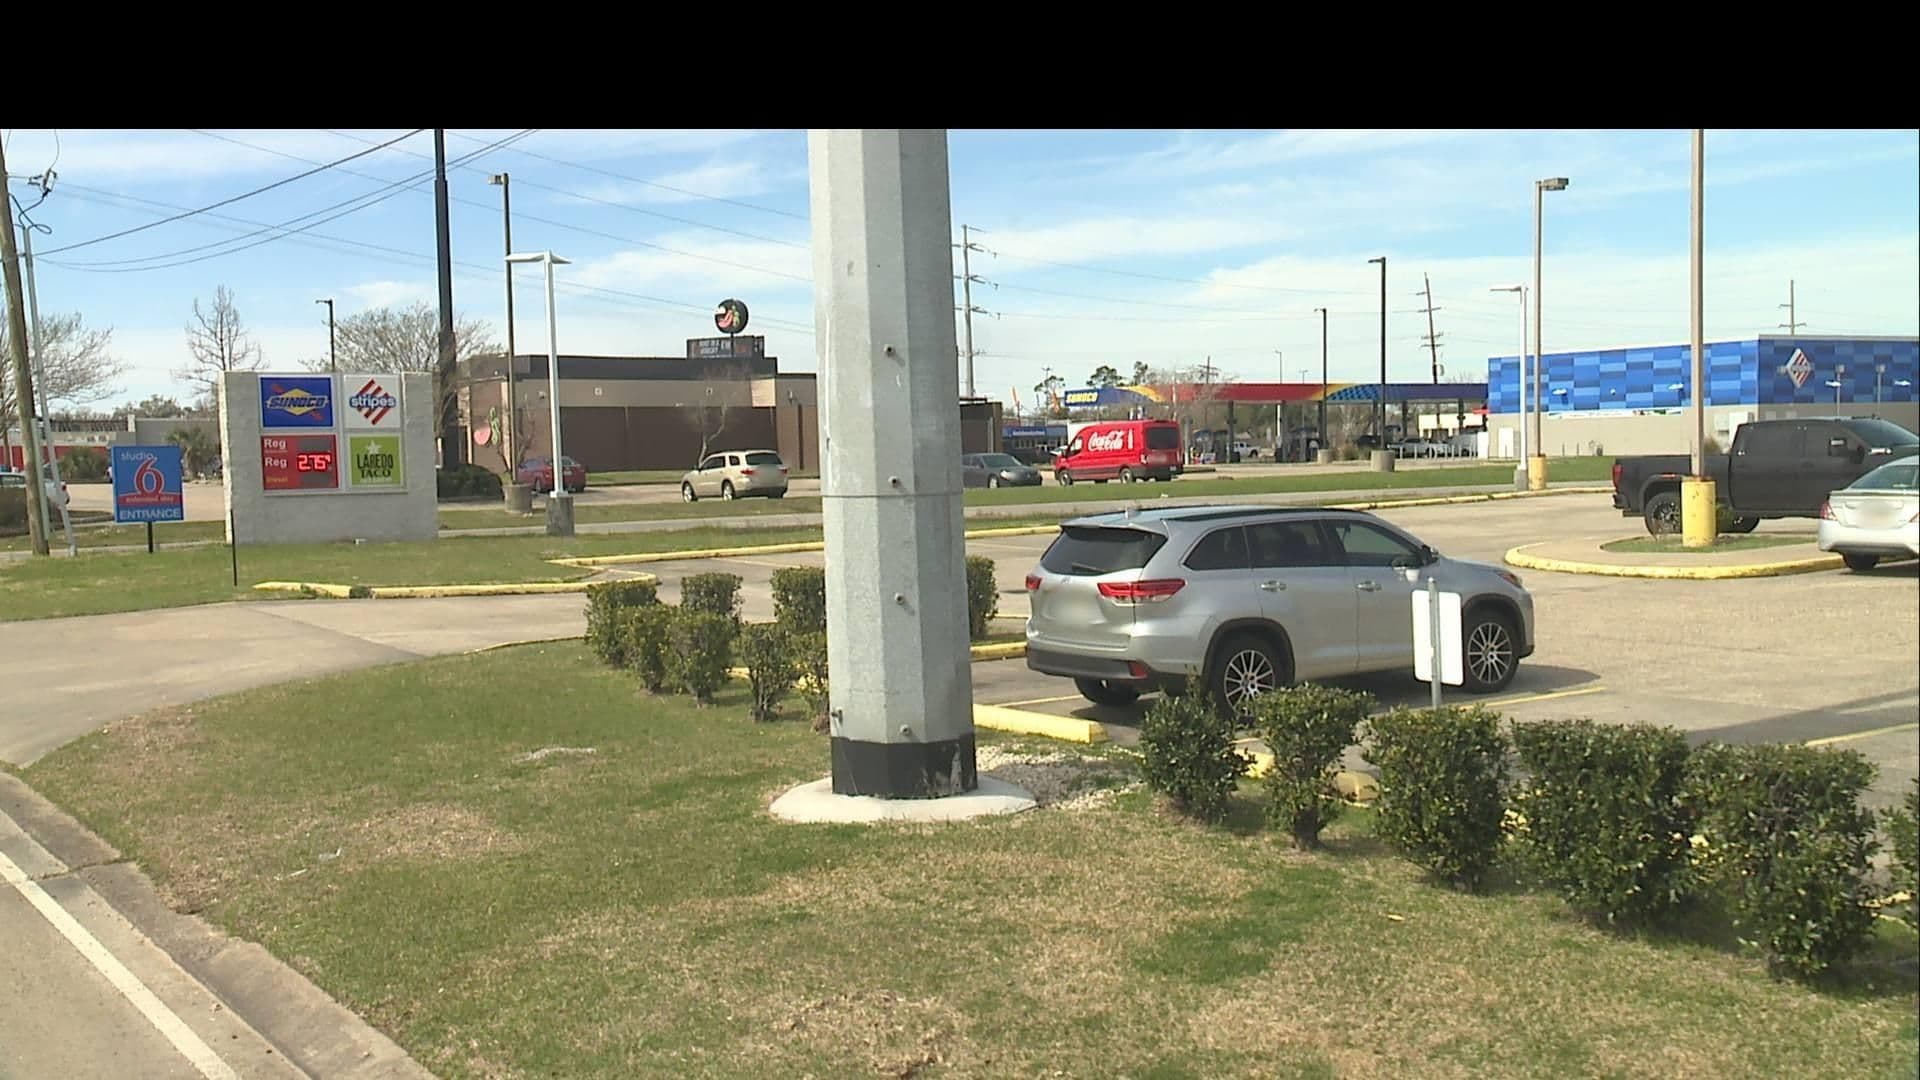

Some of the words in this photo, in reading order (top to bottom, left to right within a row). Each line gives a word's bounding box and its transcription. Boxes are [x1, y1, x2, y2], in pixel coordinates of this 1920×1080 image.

[266, 397, 327, 408] SUNOCO
[350, 395, 396, 408] stripes
[264, 439, 287, 449] Reg
[121, 451, 155, 461] studio
[357, 454, 393, 469] LAREDO
[265, 457, 288, 468] Reg
[134, 457, 165, 493] 6
[361, 469, 391, 478] TACO
[120, 508, 181, 519] ENTRANCE
